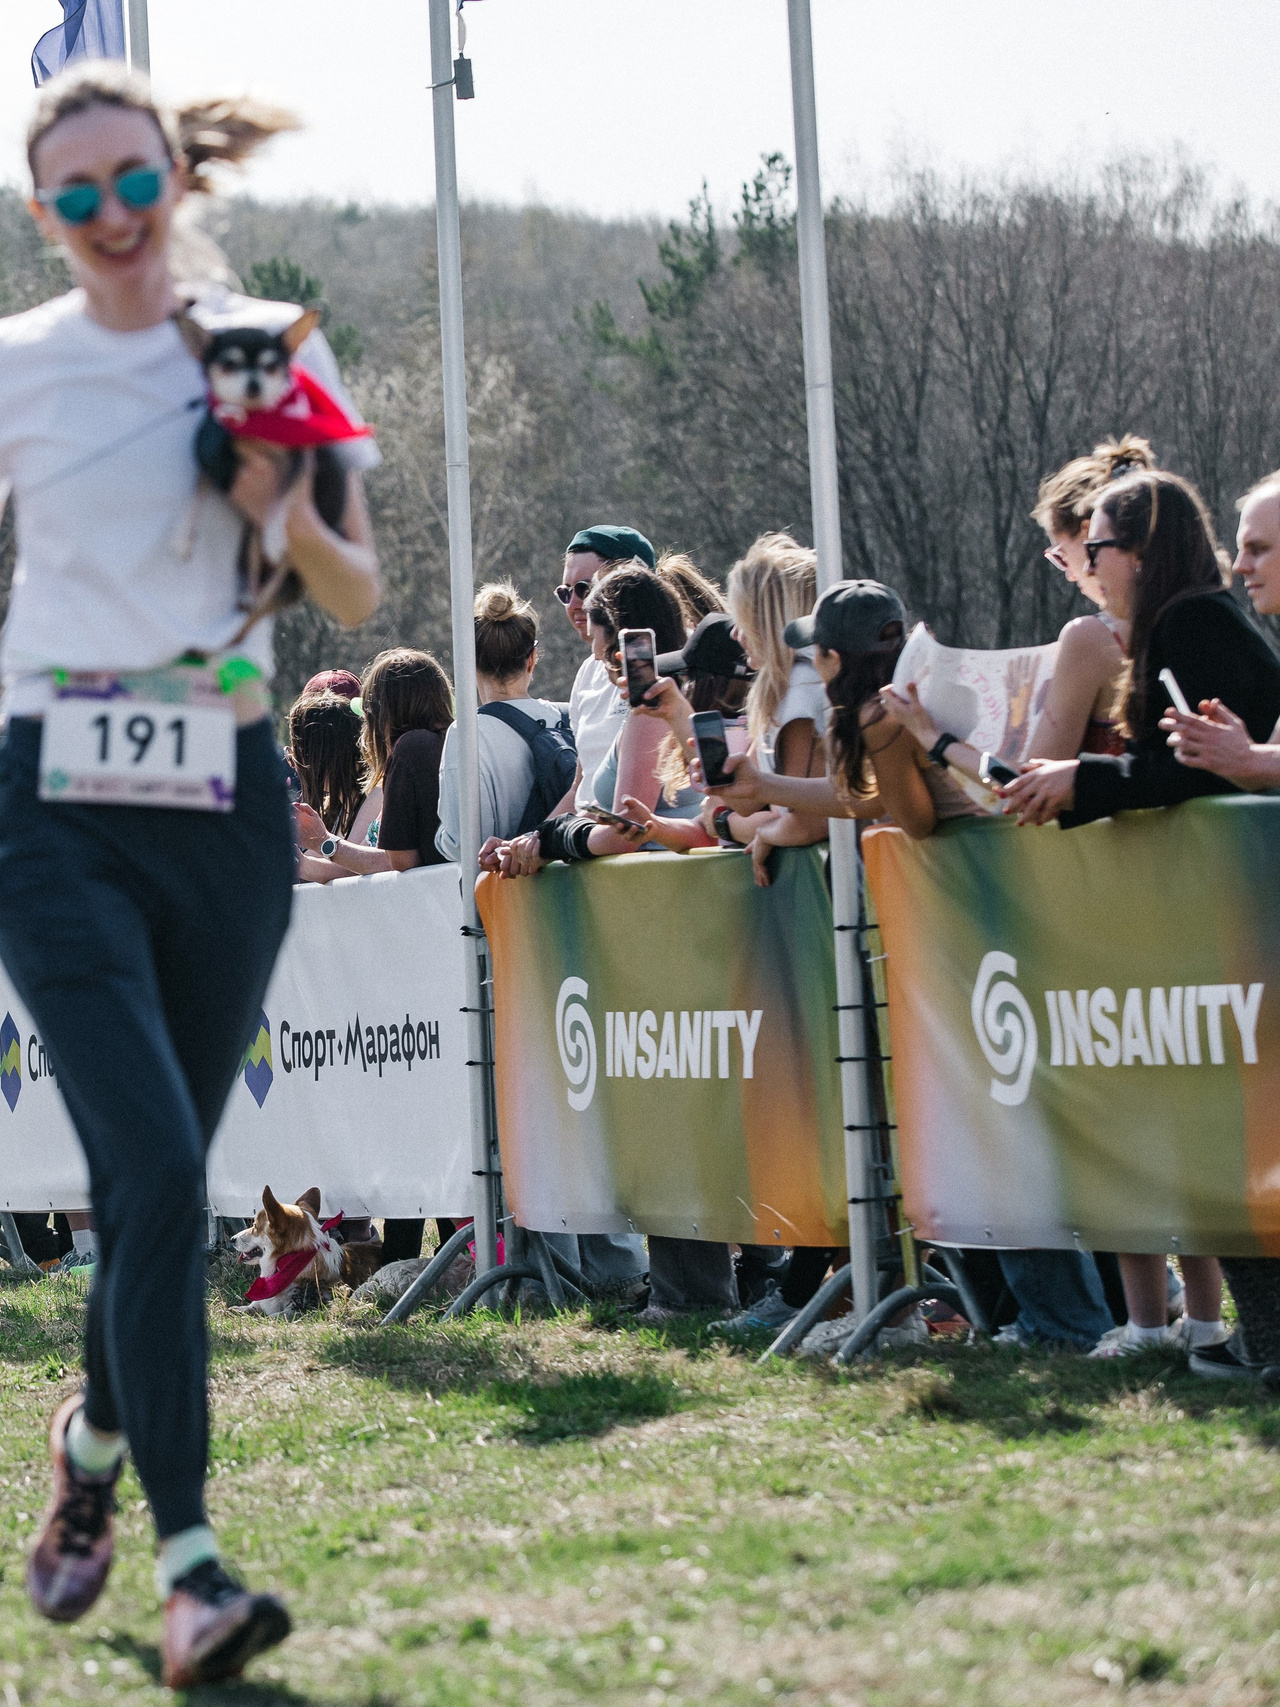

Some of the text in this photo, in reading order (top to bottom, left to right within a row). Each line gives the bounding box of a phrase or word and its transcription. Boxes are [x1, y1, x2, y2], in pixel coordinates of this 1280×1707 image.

[92, 713, 186, 767] 191
[605, 1009, 764, 1080] INSANITY
[1044, 982, 1265, 1068] INSANITY
